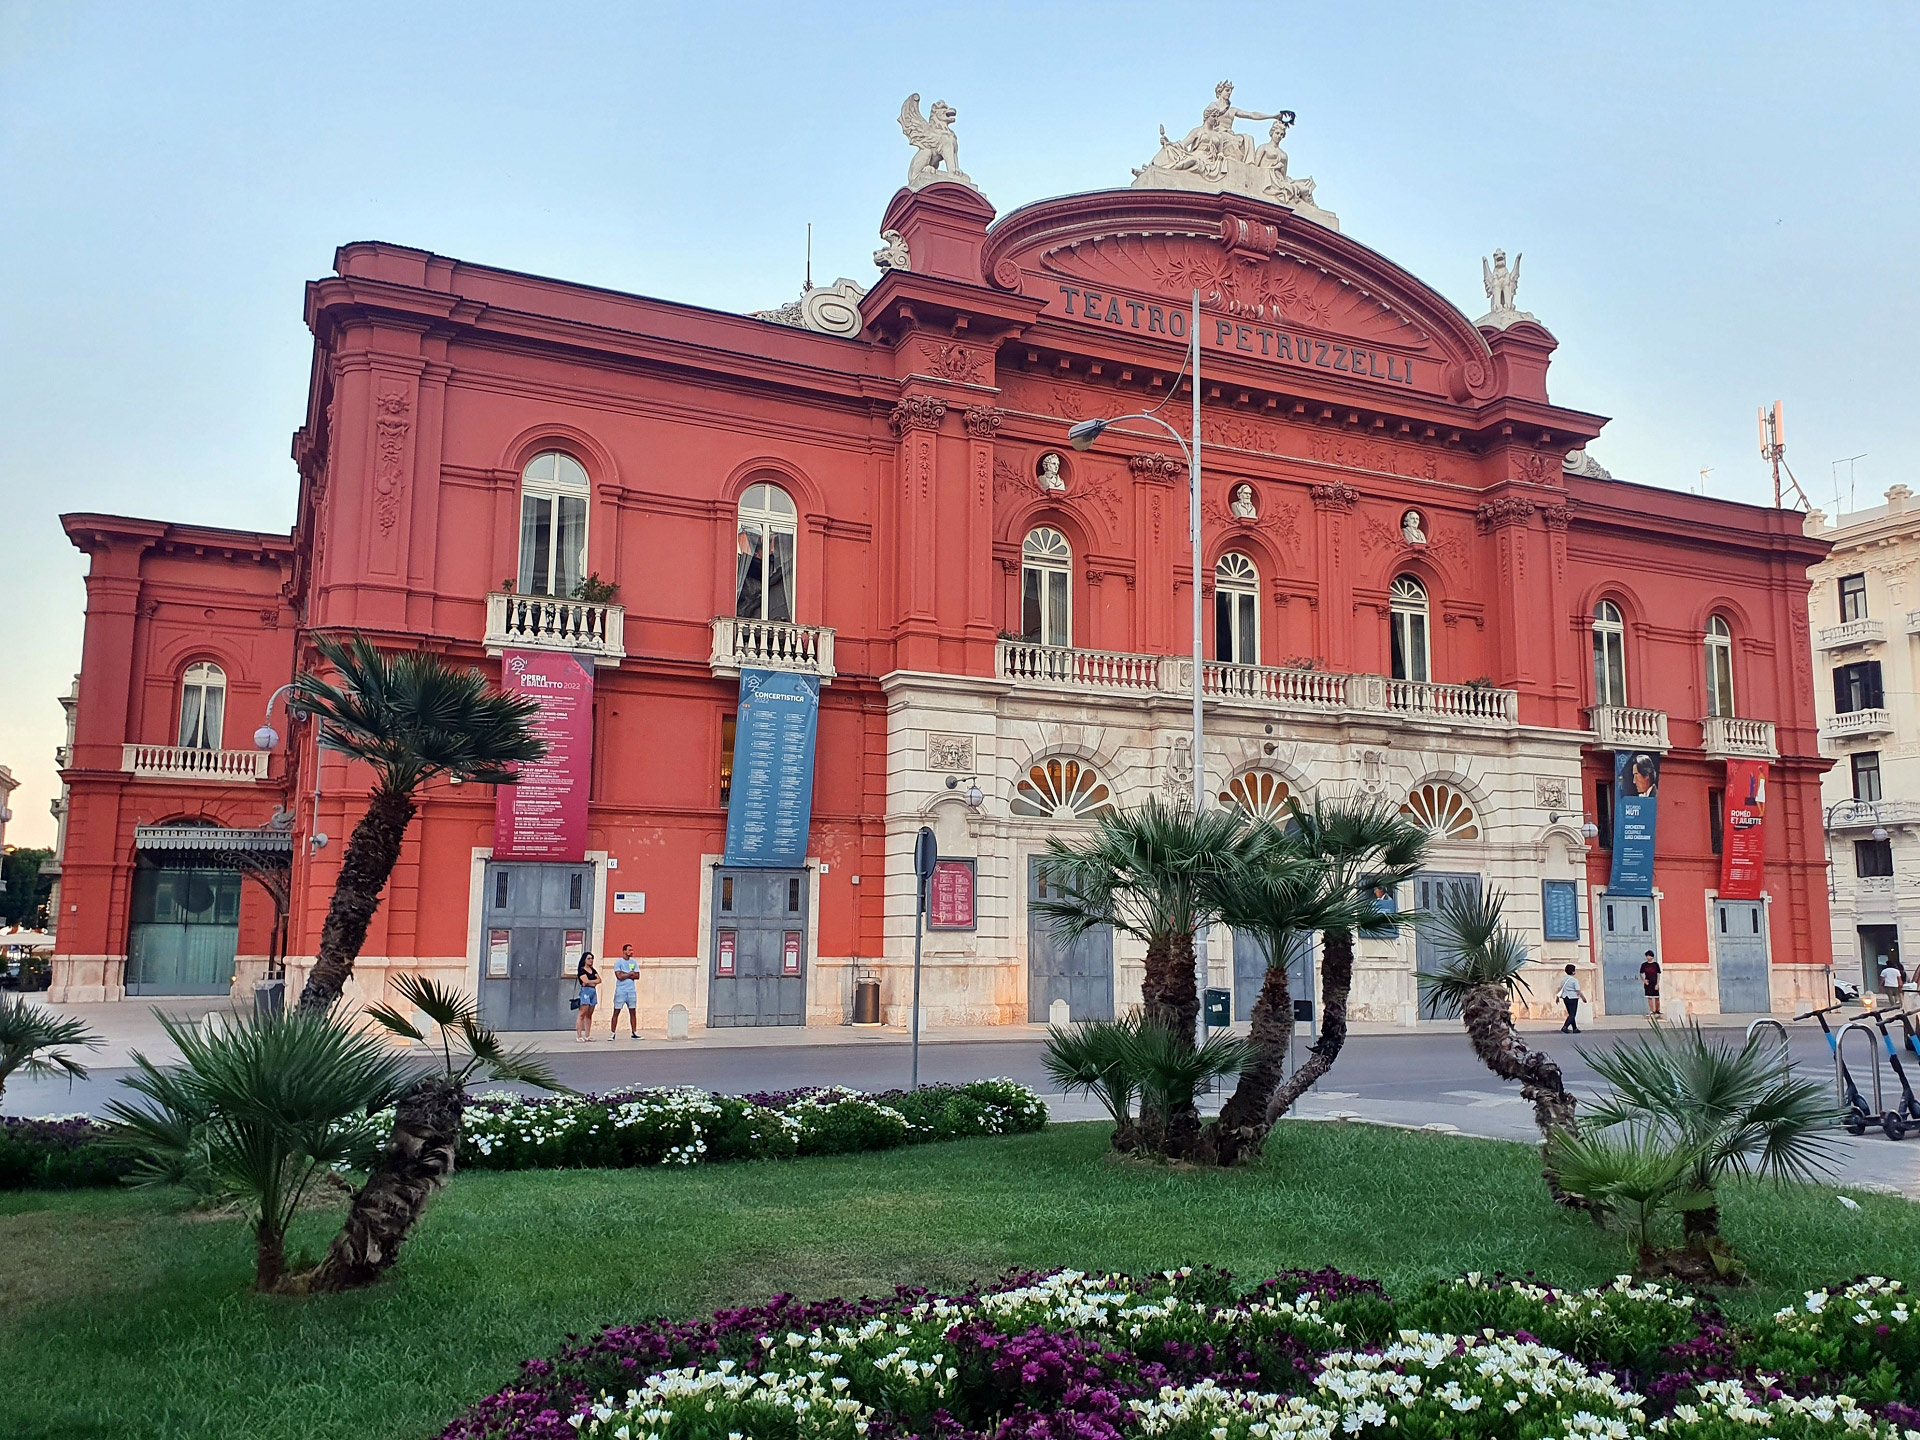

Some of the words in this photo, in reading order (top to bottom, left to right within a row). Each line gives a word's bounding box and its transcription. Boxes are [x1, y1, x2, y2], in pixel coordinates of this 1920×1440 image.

[1059, 286, 1185, 337] TEATRO
[1215, 320, 1413, 384] PETRUZZELLI
[526, 680, 563, 688] BALLETTO
[563, 682, 581, 690] 2022
[755, 691, 804, 702] CONCERTISTICA
